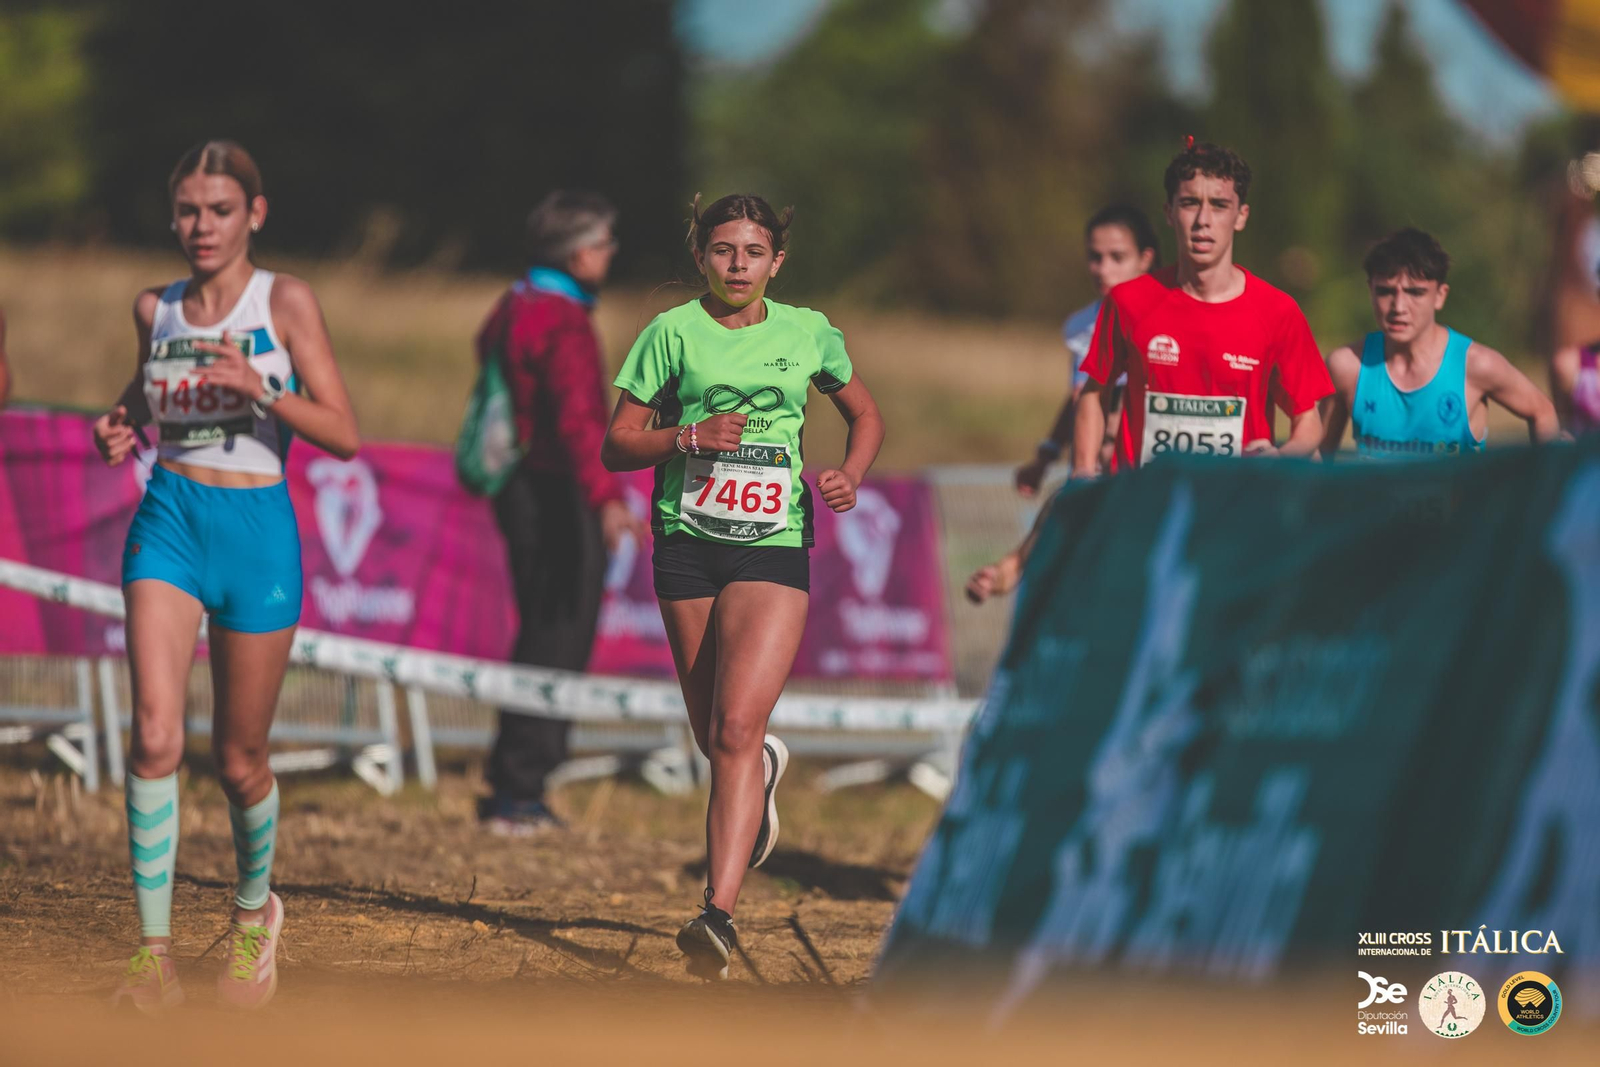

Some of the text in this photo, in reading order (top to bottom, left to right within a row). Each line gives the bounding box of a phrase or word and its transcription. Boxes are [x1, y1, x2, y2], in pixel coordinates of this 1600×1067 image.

[1172, 400, 1221, 413] ITALICA
[746, 417, 773, 431] nity
[1152, 430, 1234, 457] 8053
[719, 446, 770, 460] ALICA
[695, 475, 783, 514] 7463
